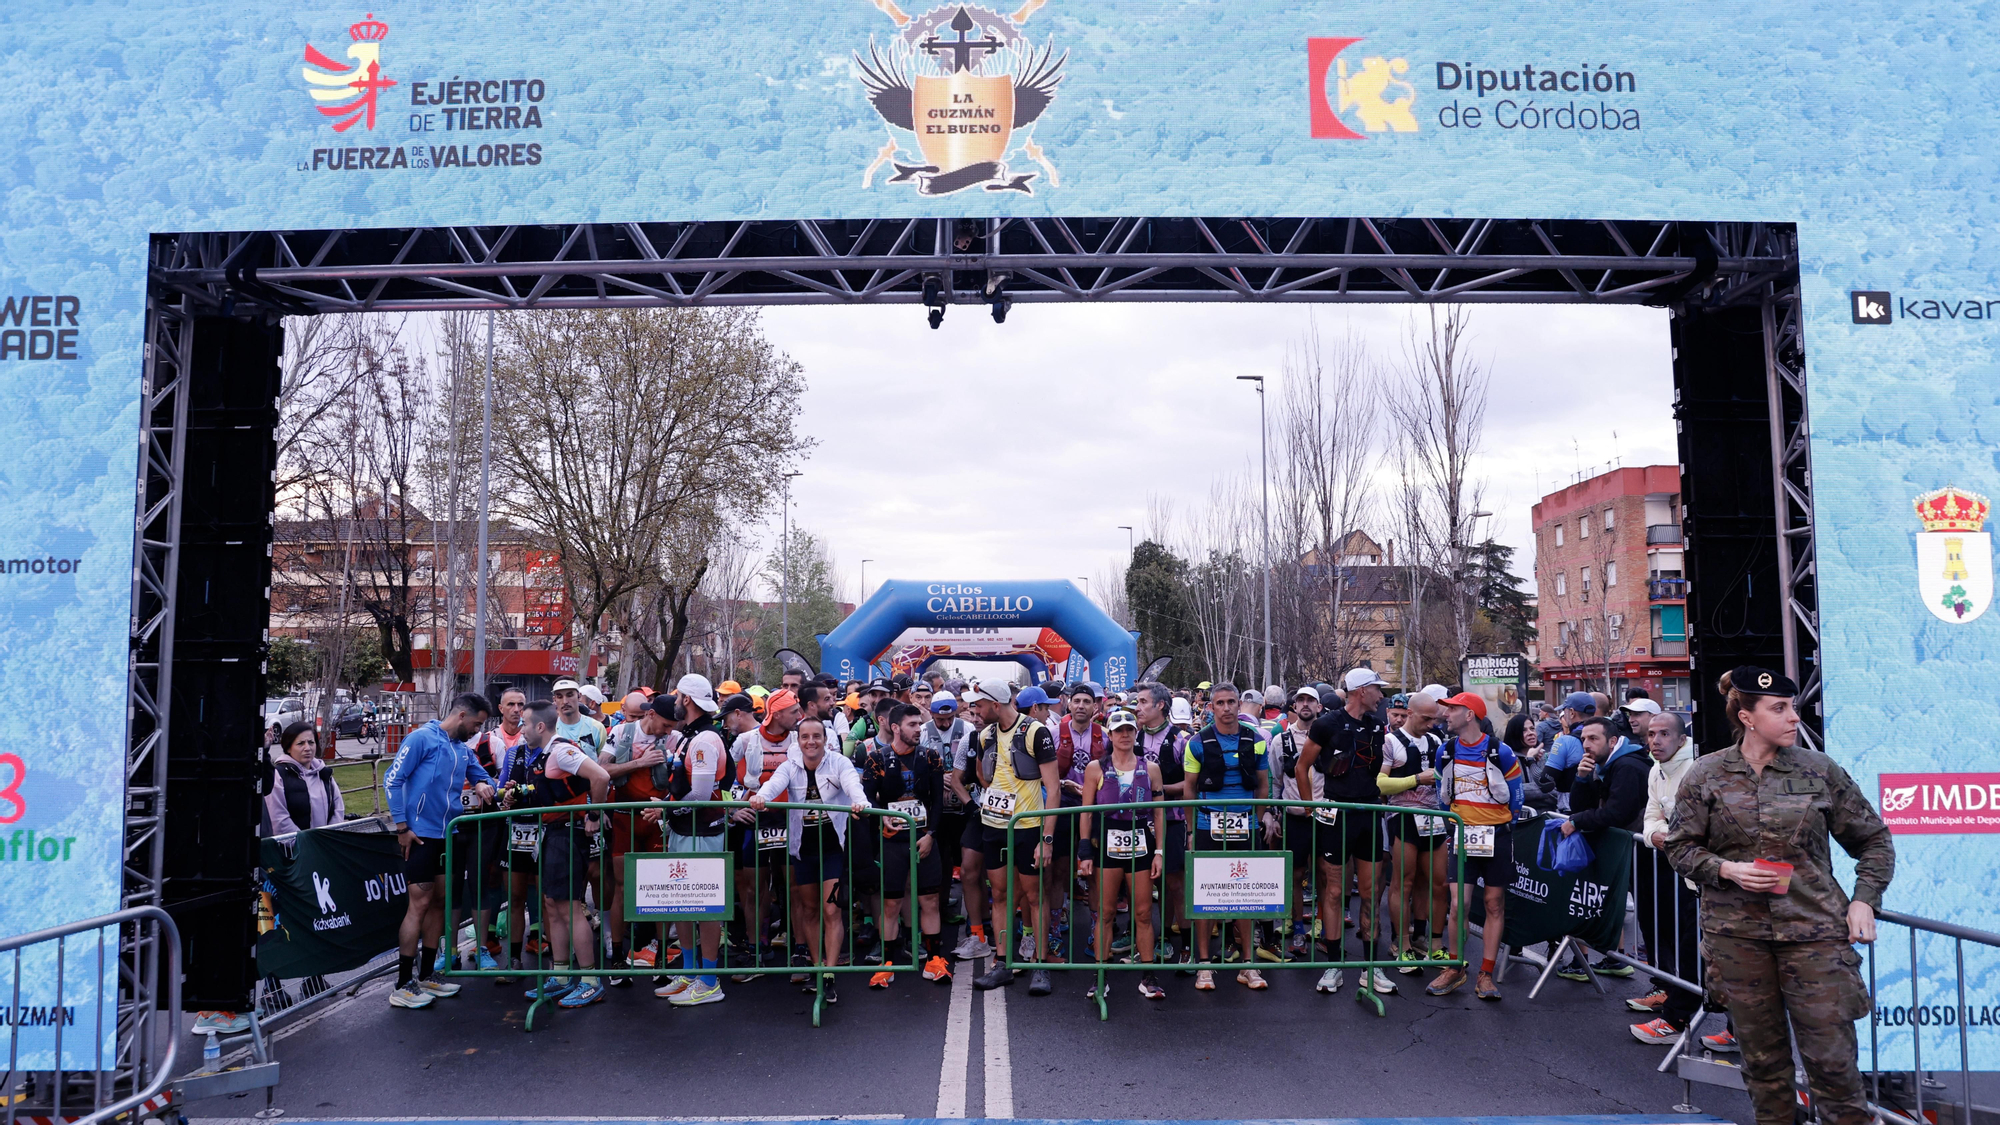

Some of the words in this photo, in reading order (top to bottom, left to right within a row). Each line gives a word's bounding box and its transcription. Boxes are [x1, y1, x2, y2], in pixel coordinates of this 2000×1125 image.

[1436, 62, 1635, 97] Diputación
[411, 76, 545, 106] EJÉRCITO
[953, 94, 974, 103] LA
[927, 106, 995, 118] GUZMÁN
[1439, 100, 1482, 128] de
[1495, 101, 1641, 130] Córdoba
[410, 114, 435, 132] DE
[442, 106, 543, 131] TIERRA
[297, 162, 309, 171] LA
[312, 146, 408, 171] FUERZA
[411, 146, 424, 156] DE
[429, 143, 543, 168] VALORES
[411, 158, 430, 169] LOS
[926, 583, 983, 596] Ciclos
[926, 595, 1034, 613] CABELLO
[560, 655, 580, 672] CEPS
[1468, 657, 1519, 669] BARRIGAS
[1468, 667, 1520, 677] CERVECERAS
[987, 795, 1009, 809] 673
[1217, 818, 1243, 829] 524
[1883, 816, 1919, 825] Instituto
[1920, 816, 1962, 826] Municipal
[515, 831, 538, 840] 971
[0, 829, 76, 861] flor
[691, 882, 719, 890] CÓRDOBA
[1252, 881, 1279, 889] CÓRDOBA
[1509, 875, 1549, 898] BELLO
